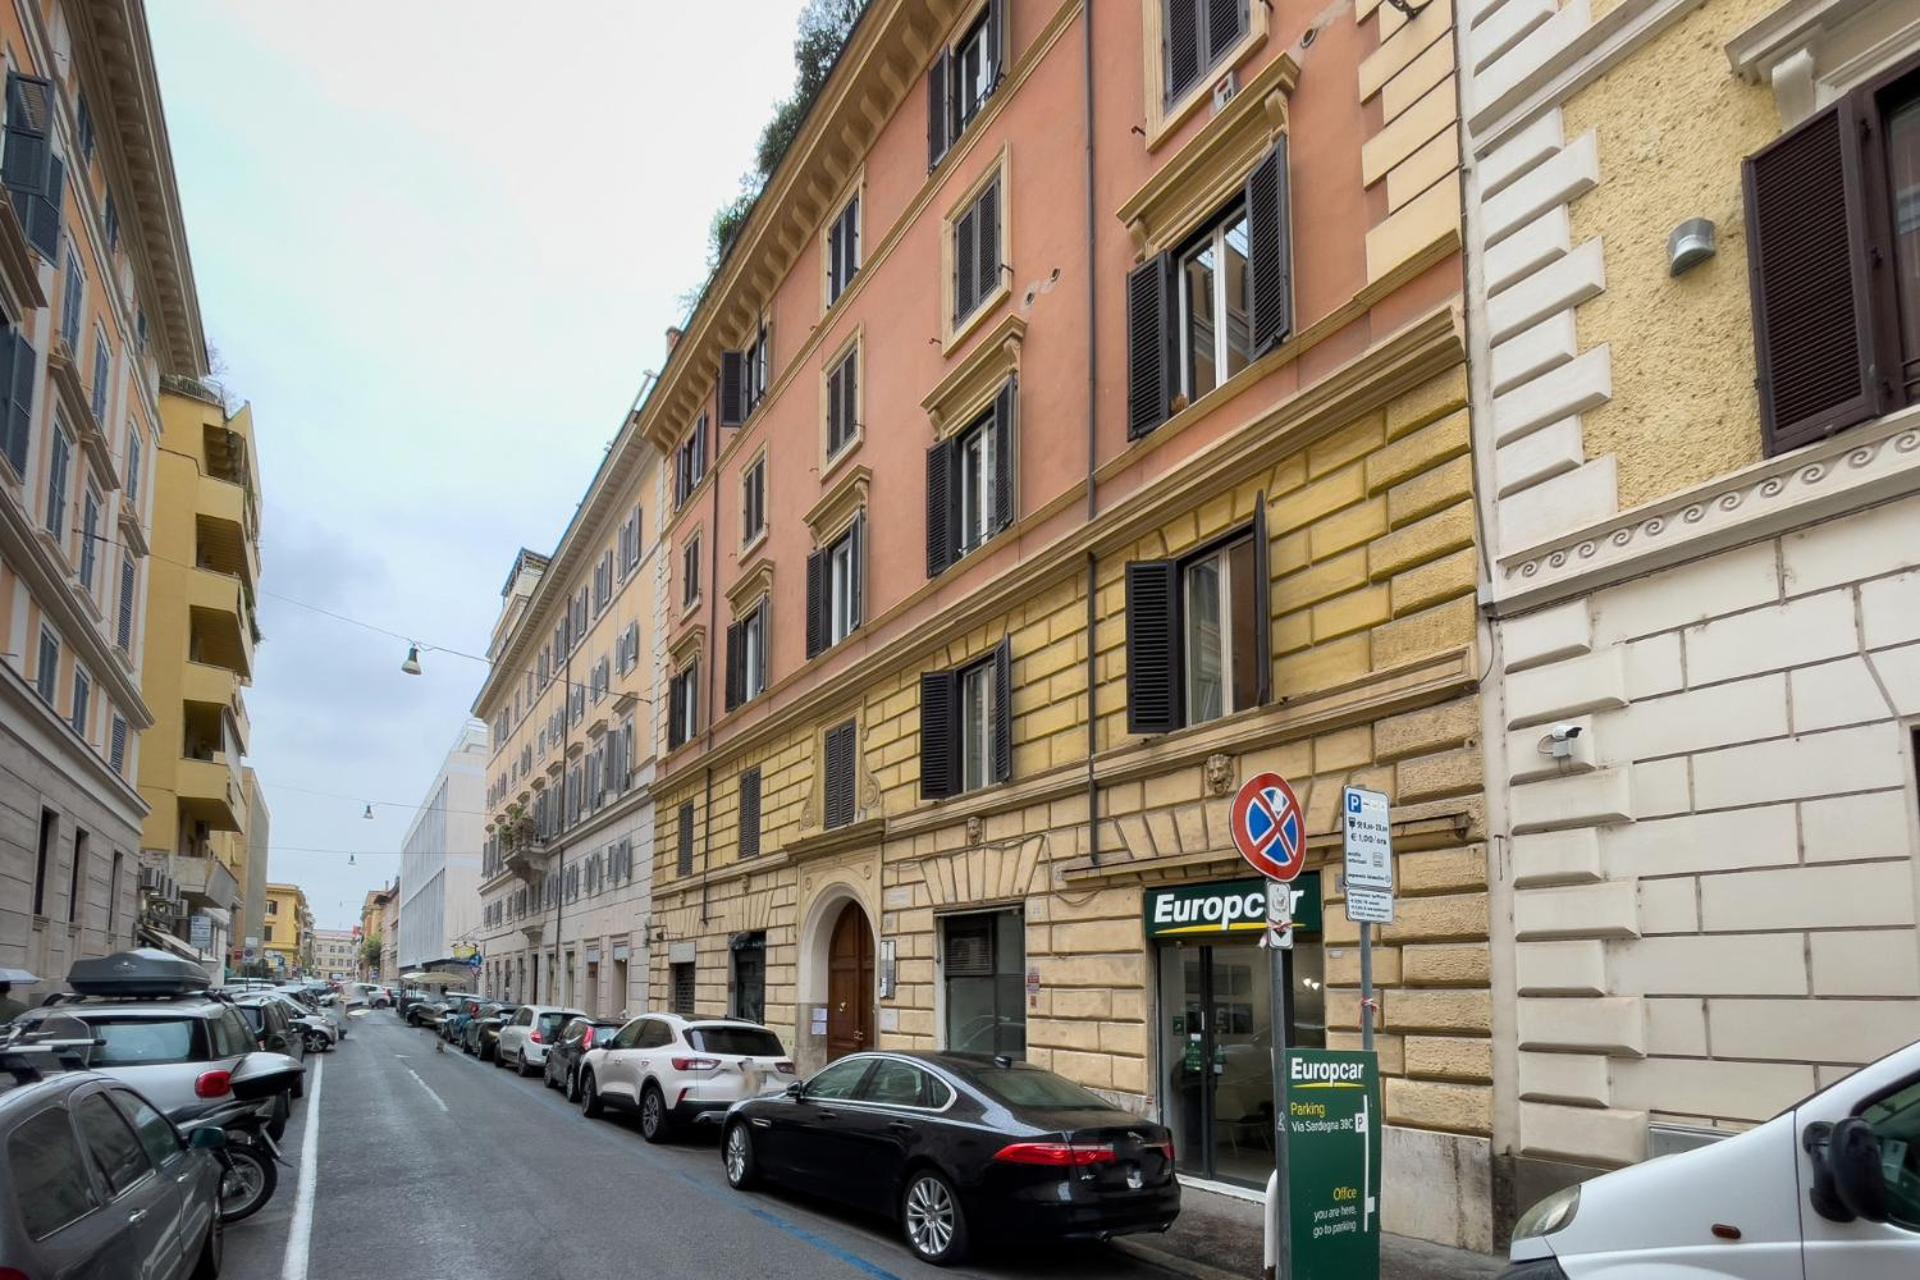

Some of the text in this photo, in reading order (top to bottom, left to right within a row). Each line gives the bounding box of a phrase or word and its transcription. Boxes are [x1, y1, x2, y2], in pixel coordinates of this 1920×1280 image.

[1350, 795, 1359, 811] P
[1154, 890, 1304, 931] Europcr
[1291, 1057, 1364, 1087] Europcar
[1290, 1102, 1326, 1119] Parking
[1291, 1121, 1305, 1133] Via
[1357, 1116, 1363, 1129] P
[1333, 1186, 1357, 1201] Office
[1313, 1210, 1328, 1223] you
[1328, 1208, 1340, 1218] are
[1313, 1220, 1357, 1239] go to parking
